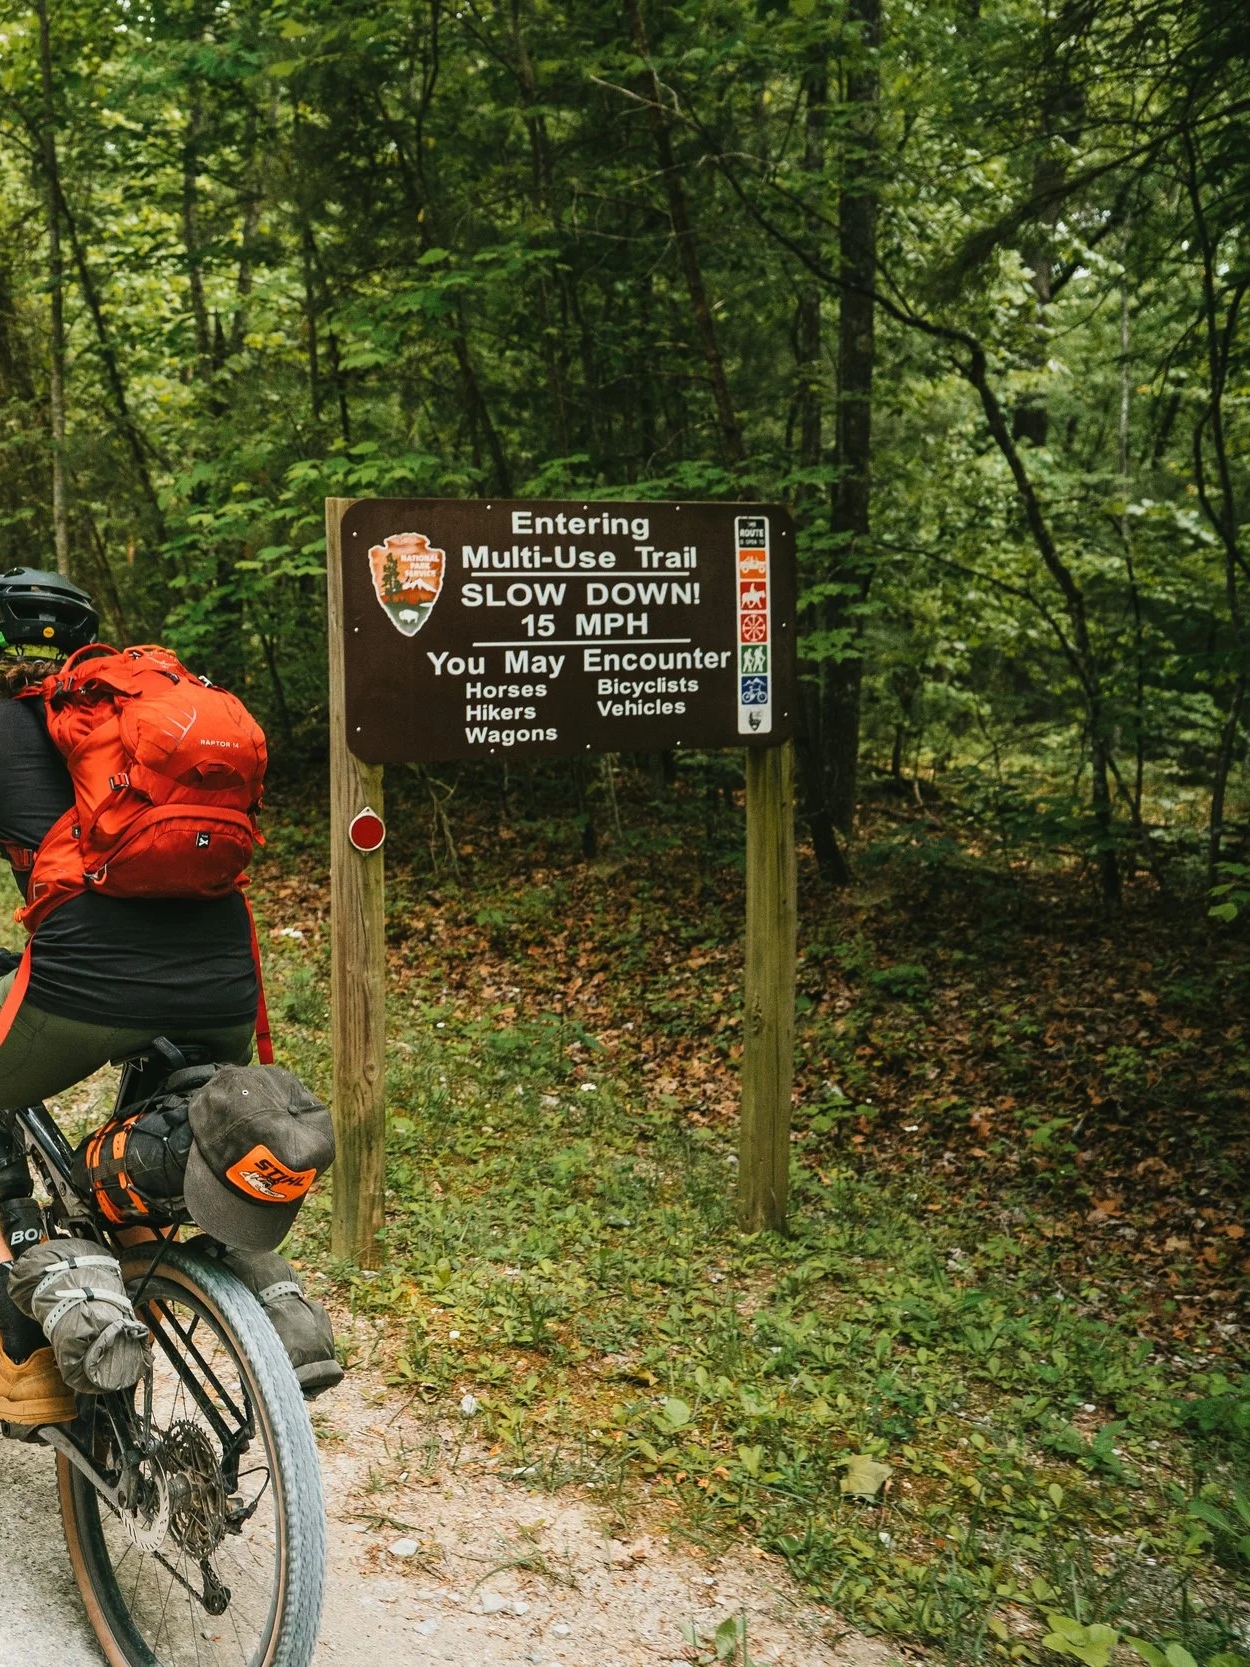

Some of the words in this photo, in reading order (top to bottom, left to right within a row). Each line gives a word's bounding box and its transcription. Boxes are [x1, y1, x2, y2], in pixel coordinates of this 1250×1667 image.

[512, 512, 649, 540] Entering
[739, 528, 764, 537] ROUTE
[400, 553, 440, 562] NATIONAL
[410, 562, 431, 570] PARK
[462, 546, 616, 569] Multi-Use
[634, 545, 697, 569] Trail
[405, 569, 437, 577] SERVICE
[461, 583, 567, 607] SLOW
[587, 582, 701, 606] DOWN!
[522, 614, 555, 637] 15
[576, 613, 648, 636] MPH
[427, 652, 485, 676] You
[505, 650, 566, 679] May
[583, 648, 732, 672] Encounter
[466, 682, 548, 699] Horses
[597, 677, 699, 697] Bicyclists
[466, 704, 537, 721] Hikers
[597, 699, 686, 717] Vehicles
[200, 739, 231, 748] RAPTOR
[465, 726, 558, 746] Wagons
[254, 1159, 305, 1186] STIHL
